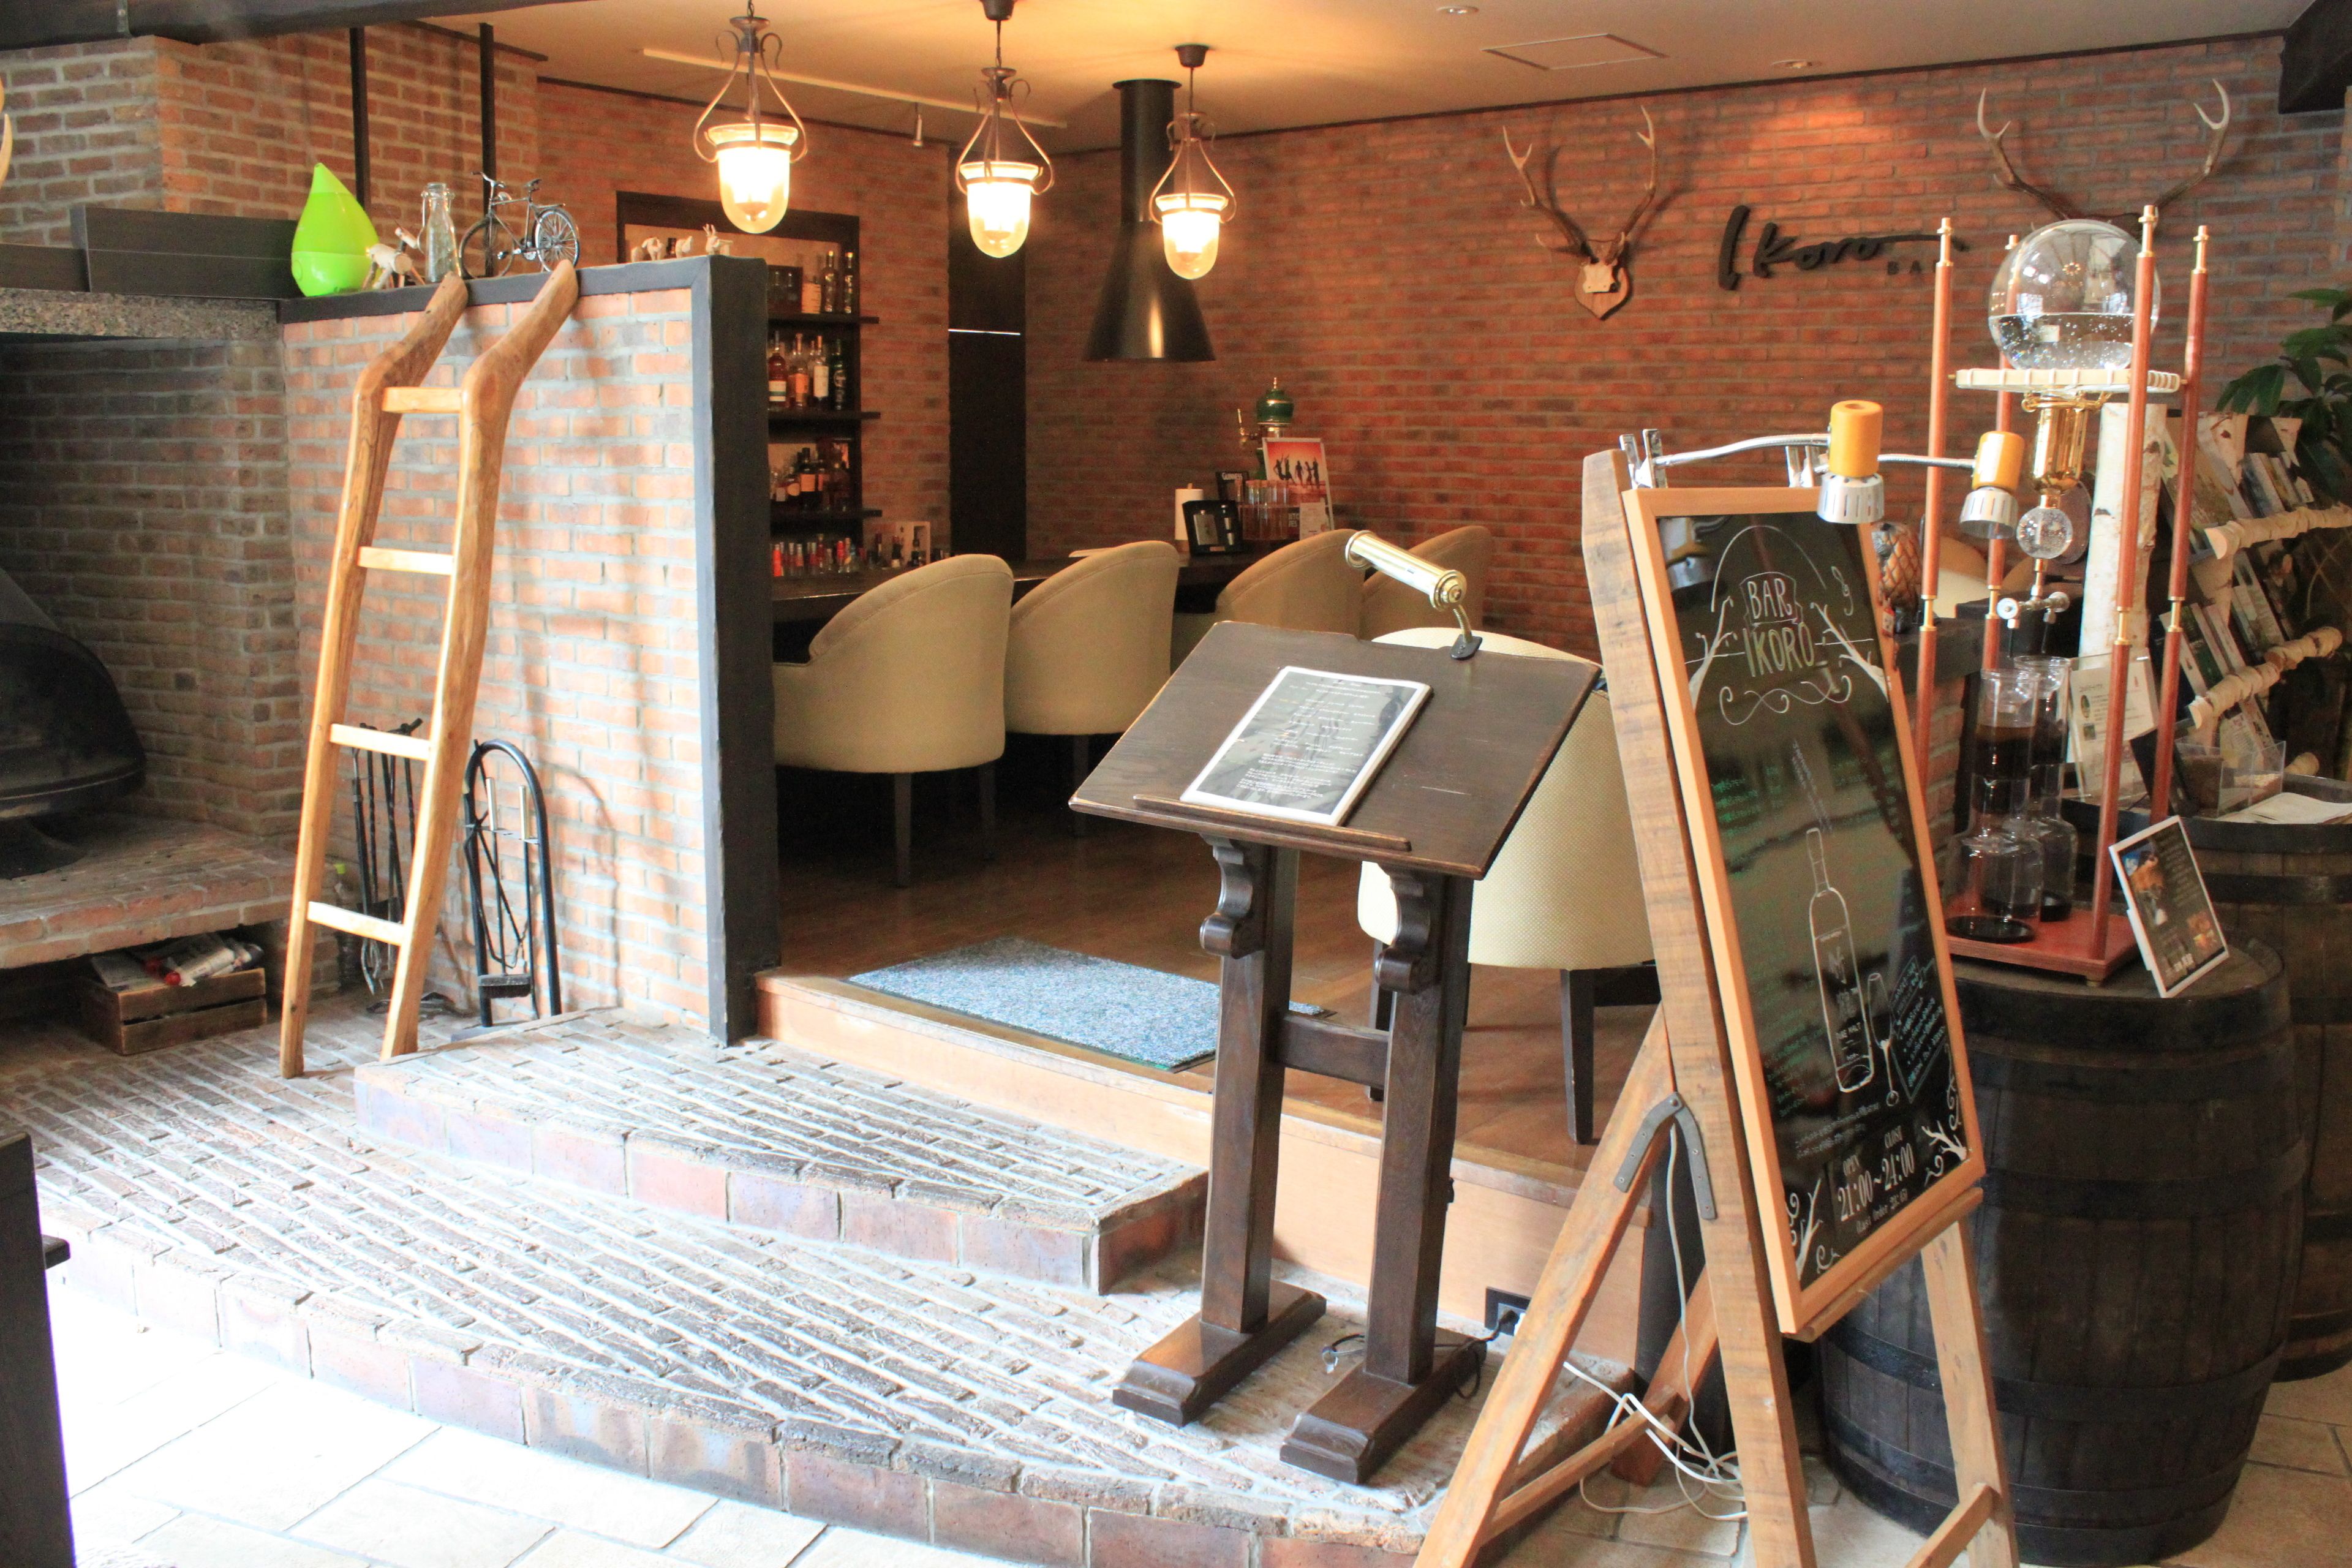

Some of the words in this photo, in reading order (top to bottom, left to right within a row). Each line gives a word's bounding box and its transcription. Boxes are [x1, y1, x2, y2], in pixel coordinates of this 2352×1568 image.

[1887, 260, 1936, 276] BA
[1747, 578, 1793, 620] BAR
[1742, 622, 1815, 677] IKORO
